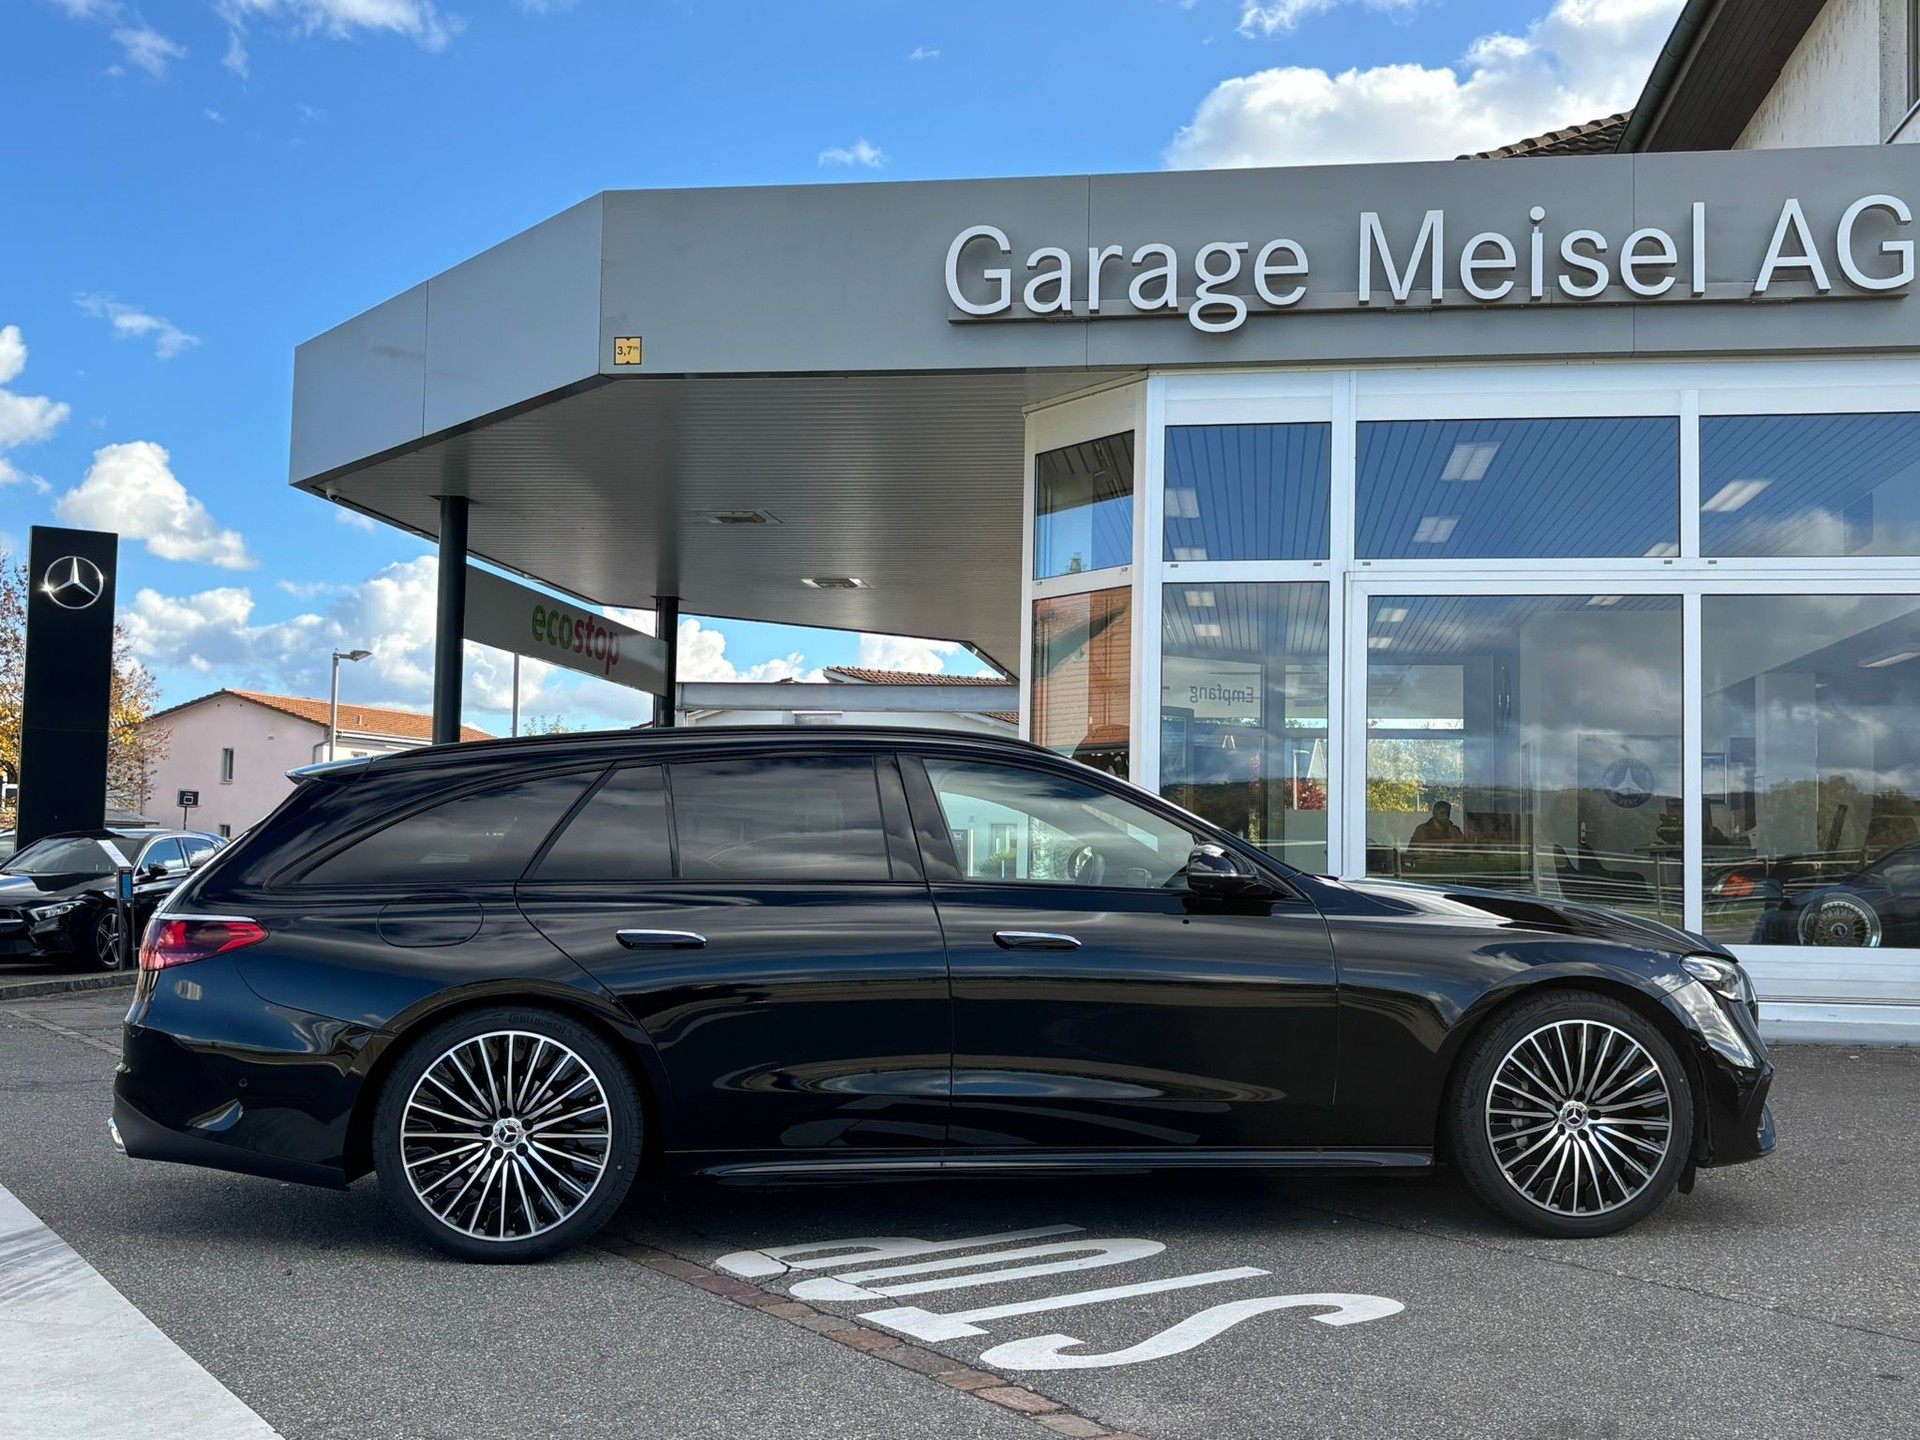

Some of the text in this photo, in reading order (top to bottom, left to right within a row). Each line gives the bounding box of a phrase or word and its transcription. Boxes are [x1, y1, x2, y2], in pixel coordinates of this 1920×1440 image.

[944, 194, 1915, 334] Garage Meisel AG
[532, 605, 620, 675] ecostop
[715, 1223, 1405, 1371] STOP
